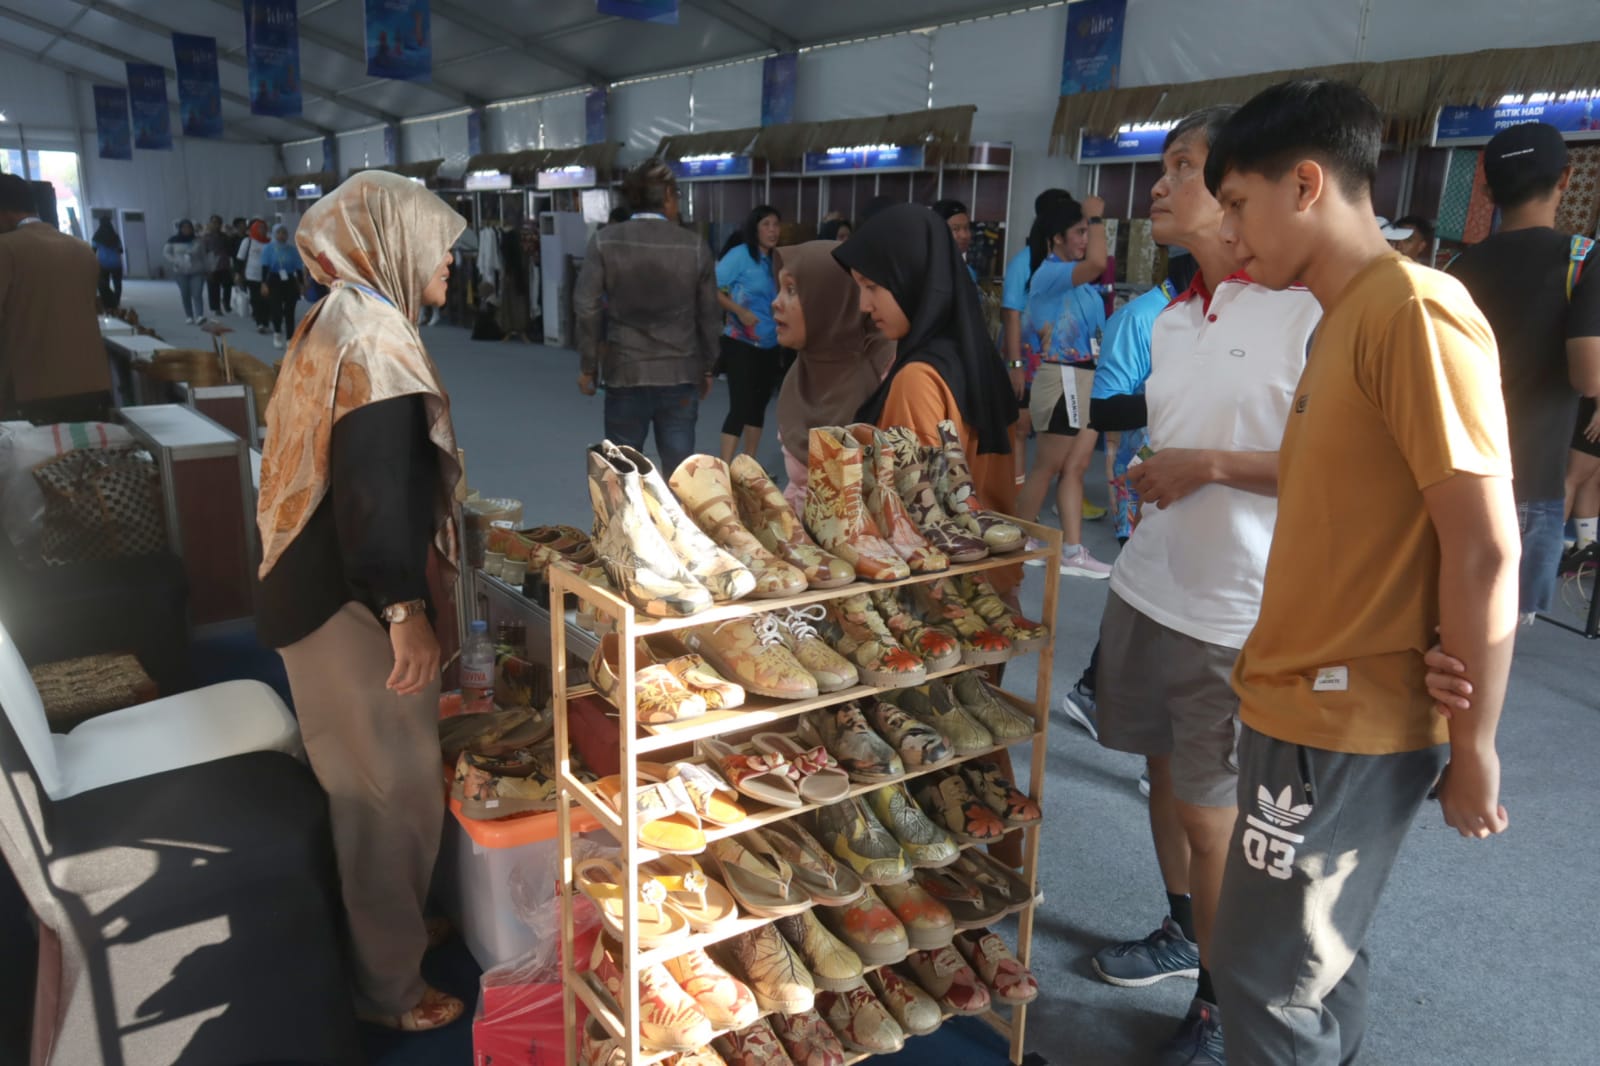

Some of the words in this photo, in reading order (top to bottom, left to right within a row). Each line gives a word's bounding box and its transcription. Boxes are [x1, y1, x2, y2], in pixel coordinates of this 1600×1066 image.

[1494, 108, 1521, 118] BATIK
[1521, 106, 1545, 117] HADI
[1242, 828, 1296, 880] 03
